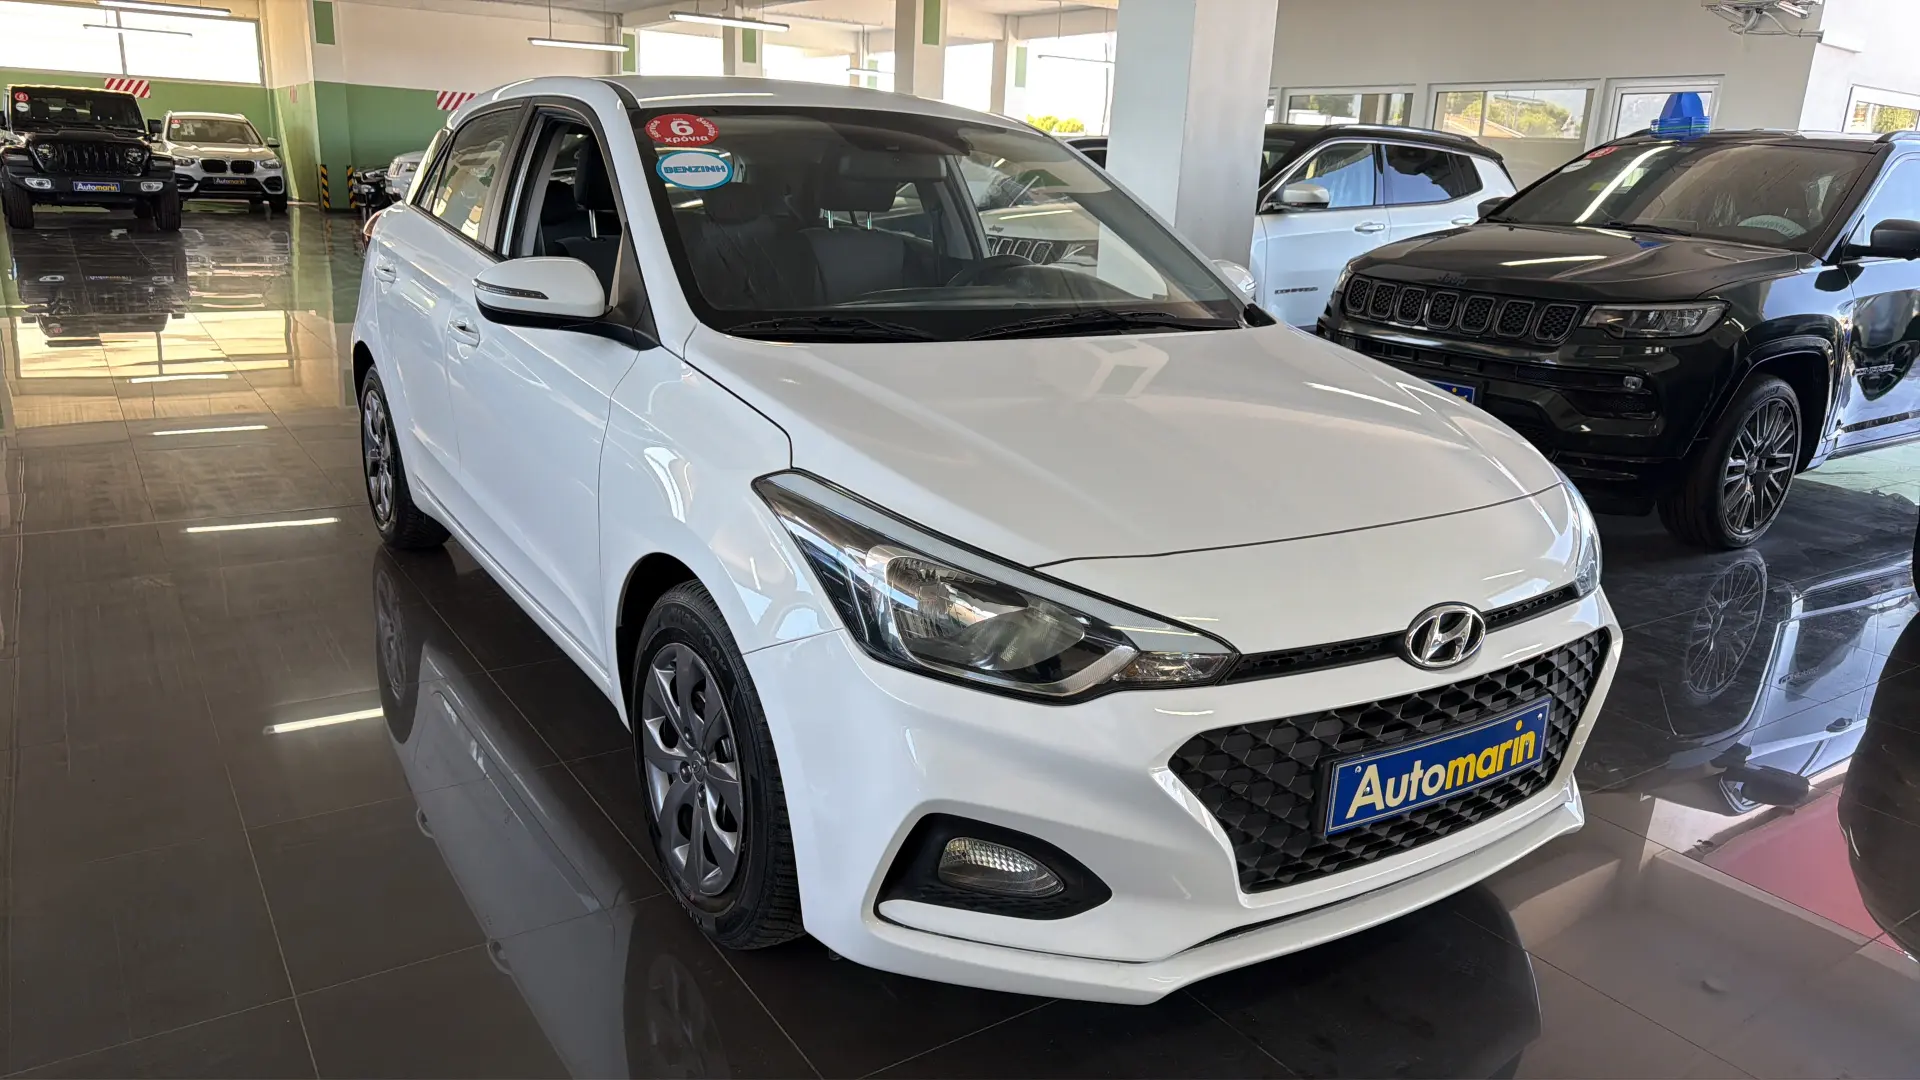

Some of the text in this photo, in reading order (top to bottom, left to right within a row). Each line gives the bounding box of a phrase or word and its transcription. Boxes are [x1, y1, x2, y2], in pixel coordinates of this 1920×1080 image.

[670, 120, 694, 136] 6
[664, 135, 709, 144] χρόνια
[77, 182, 118, 191] Automarin
[1345, 720, 1536, 819] Automarin
